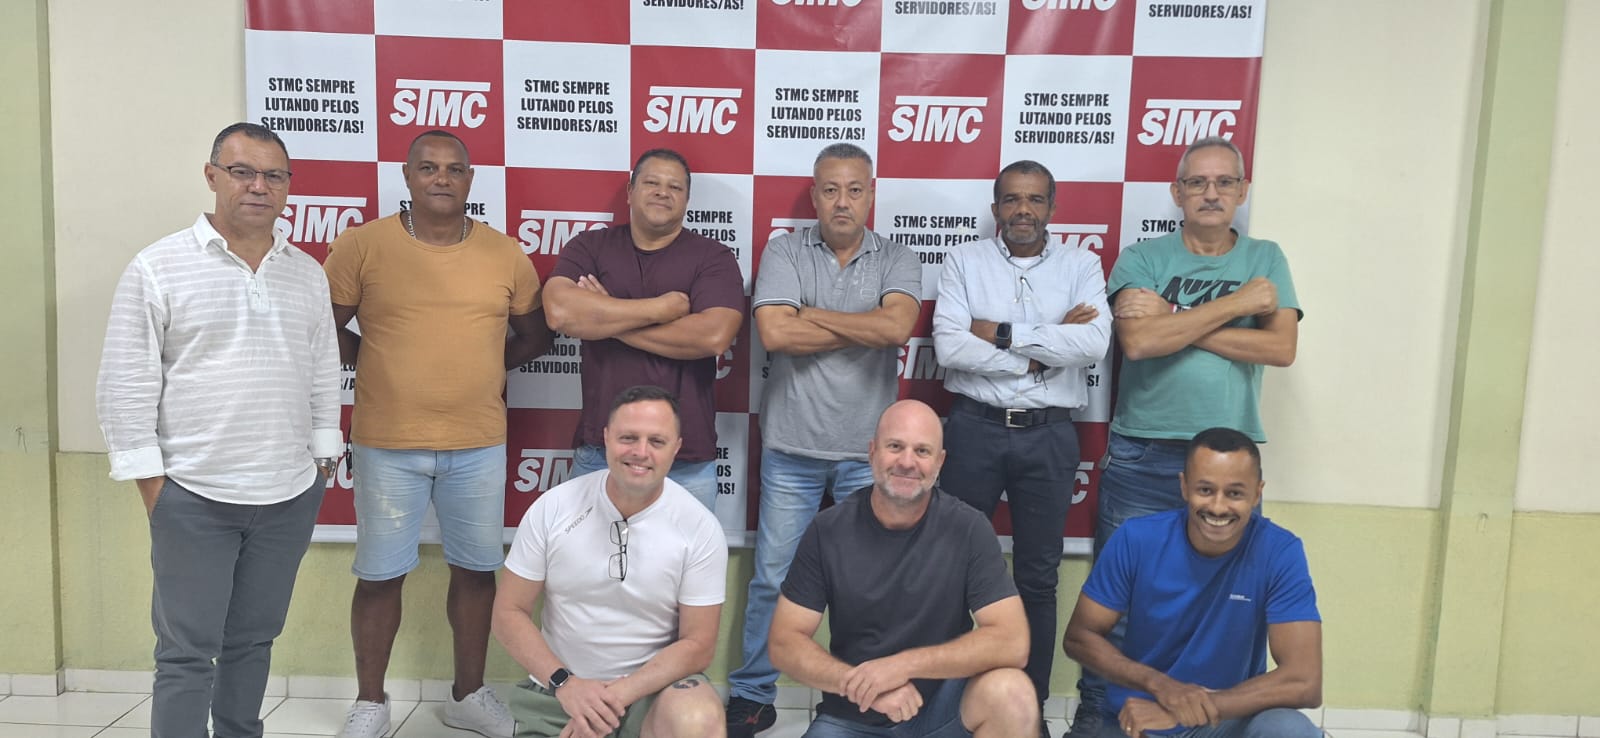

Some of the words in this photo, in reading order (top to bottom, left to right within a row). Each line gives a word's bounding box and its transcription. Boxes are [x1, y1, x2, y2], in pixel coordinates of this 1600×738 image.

[895, 1, 996, 15] SERVIDORES/AS!
[1149, 4, 1252, 18] SERVIDORES/AS!
[268, 77, 303, 92] STMC
[306, 79, 355, 94] SEMPRE
[524, 79, 559, 93] STMC
[563, 81, 610, 95] SEMPRE
[775, 88, 809, 102] STMC
[812, 89, 859, 103] SEMPRE
[1024, 93, 1058, 106] STMC
[1061, 93, 1109, 107] SEMPRE
[265, 97, 319, 112] LUTANDO
[322, 99, 359, 114] PELOS
[390, 79, 491, 129] STMC
[521, 98, 575, 113] LUTANDO
[578, 100, 614, 114] PELOS
[643, 86, 742, 135] STMC
[771, 107, 824, 121] LUTANDO
[827, 109, 862, 122] PELOS
[888, 96, 988, 144] STMC
[1020, 112, 1072, 125] LUTANDO
[1075, 112, 1112, 125] PELOS
[1137, 99, 1242, 145] STMC
[261, 117, 364, 133] SERVIDORES/AS!
[517, 116, 618, 133] SERVIDORES/AS!
[767, 125, 866, 140] SERVIDORES/AS!
[1014, 130, 1115, 145] SERVIDORES/AS!
[686, 210, 733, 223] SEMPRE
[894, 215, 927, 229] STMC
[930, 216, 977, 229] SEMPRE
[518, 209, 614, 255] STM
[1142, 220, 1176, 232] STMC
[702, 228, 736, 242] PELOS
[1160, 276, 1242, 307] NIKE
[520, 360, 582, 374] SERVIDOR
[514, 448, 576, 492] STM
